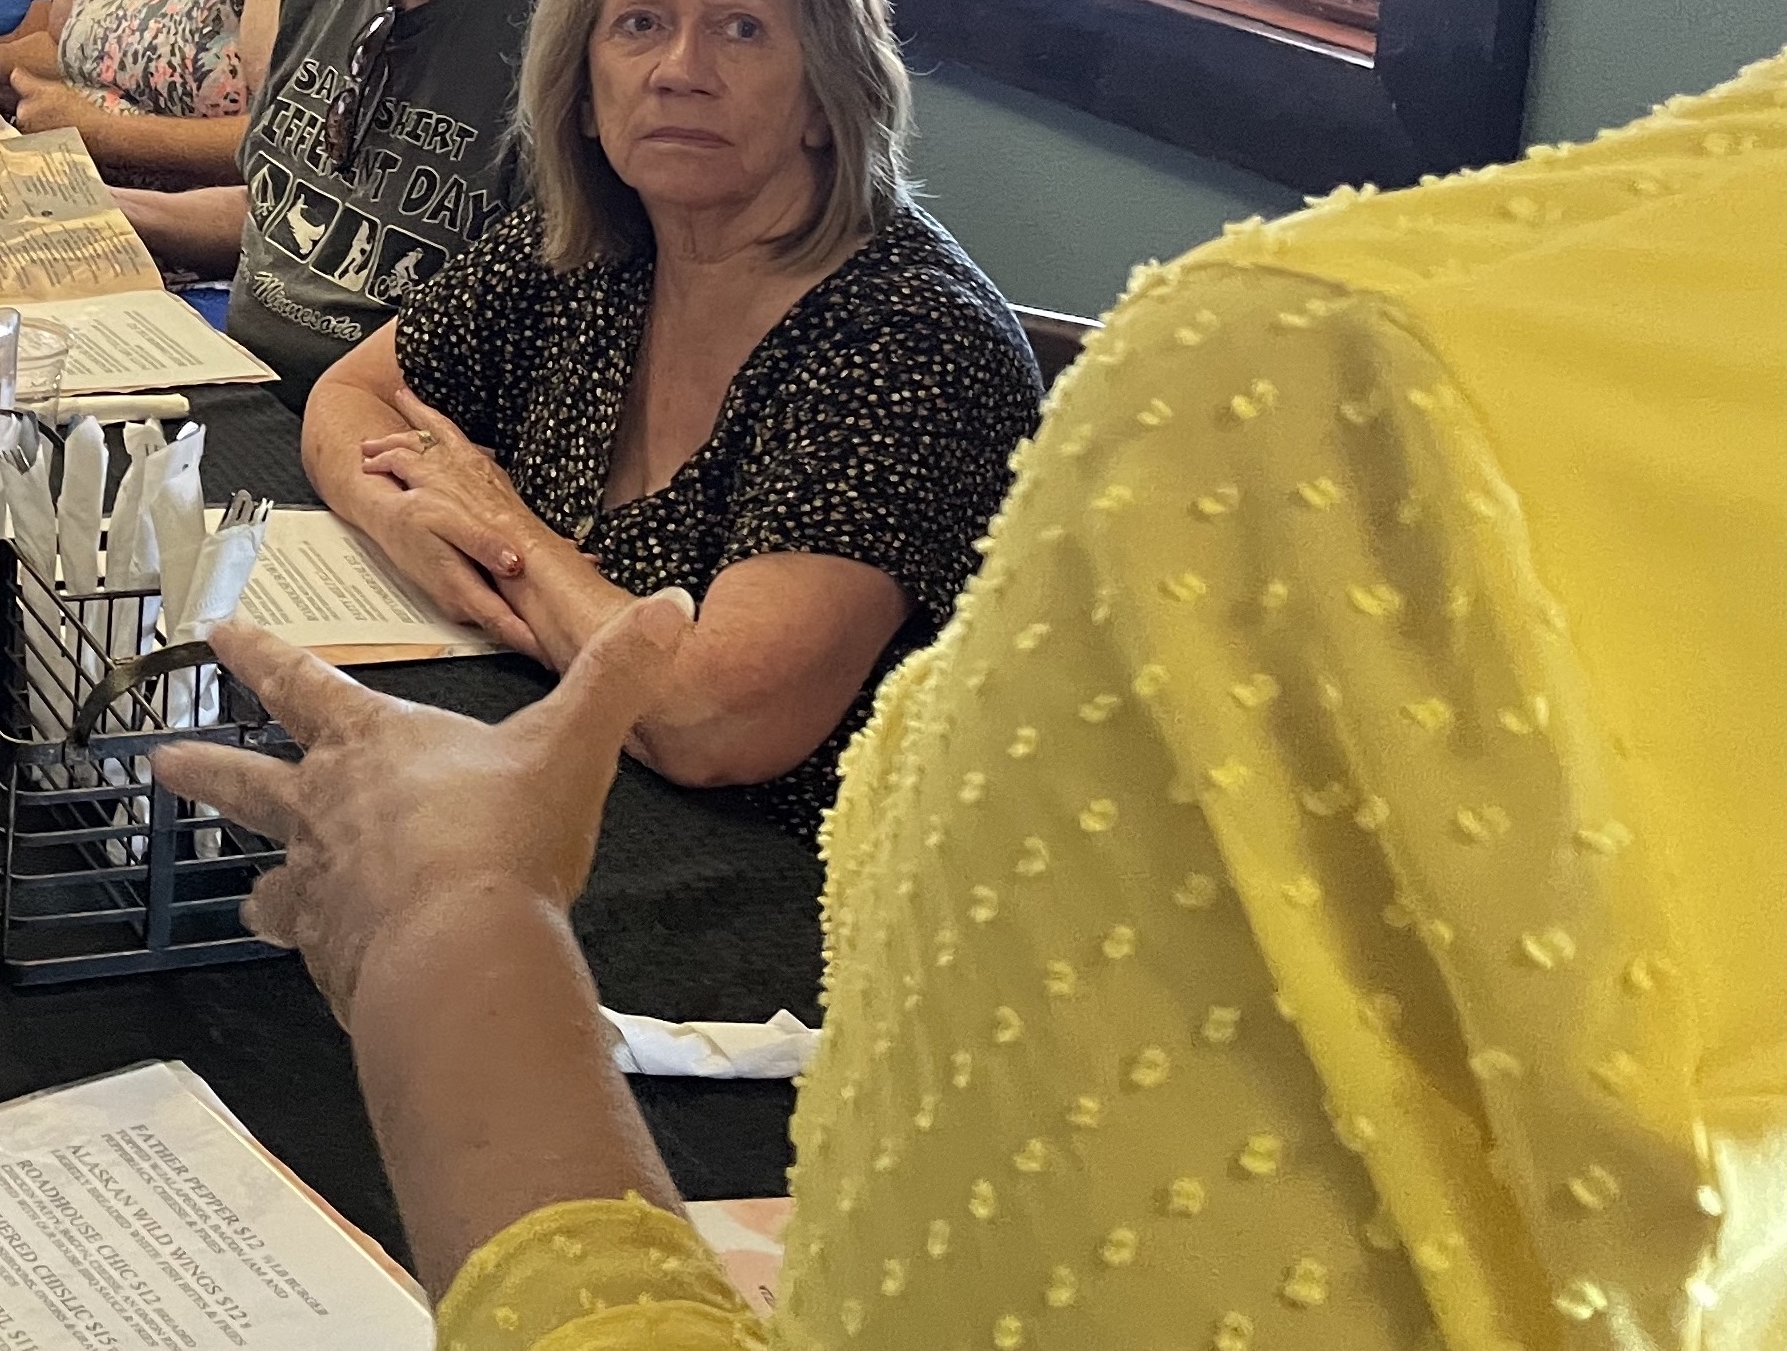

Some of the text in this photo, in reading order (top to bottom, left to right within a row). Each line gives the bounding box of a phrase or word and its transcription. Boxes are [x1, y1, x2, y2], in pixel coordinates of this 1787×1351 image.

[294, 58, 478, 162] SA SHIRT
[399, 166, 504, 243] DAY
[254, 271, 363, 341] Minnesota
[13, 1159, 105, 1244] ROADHOUSE
[93, 1243, 140, 1281] CHIC
[127, 1279, 163, 1306] $12
[64, 1142, 139, 1208] ALASKAN
[127, 1207, 177, 1247] WILD
[165, 1246, 225, 1296] WINGS
[213, 1295, 250, 1322] $12
[128, 1123, 192, 1176] FATHER
[181, 1175, 243, 1226] PEPPER
[231, 1225, 267, 1250] $12
[30, 1262, 96, 1322] CHISLIC
[82, 1320, 119, 1347] $15
